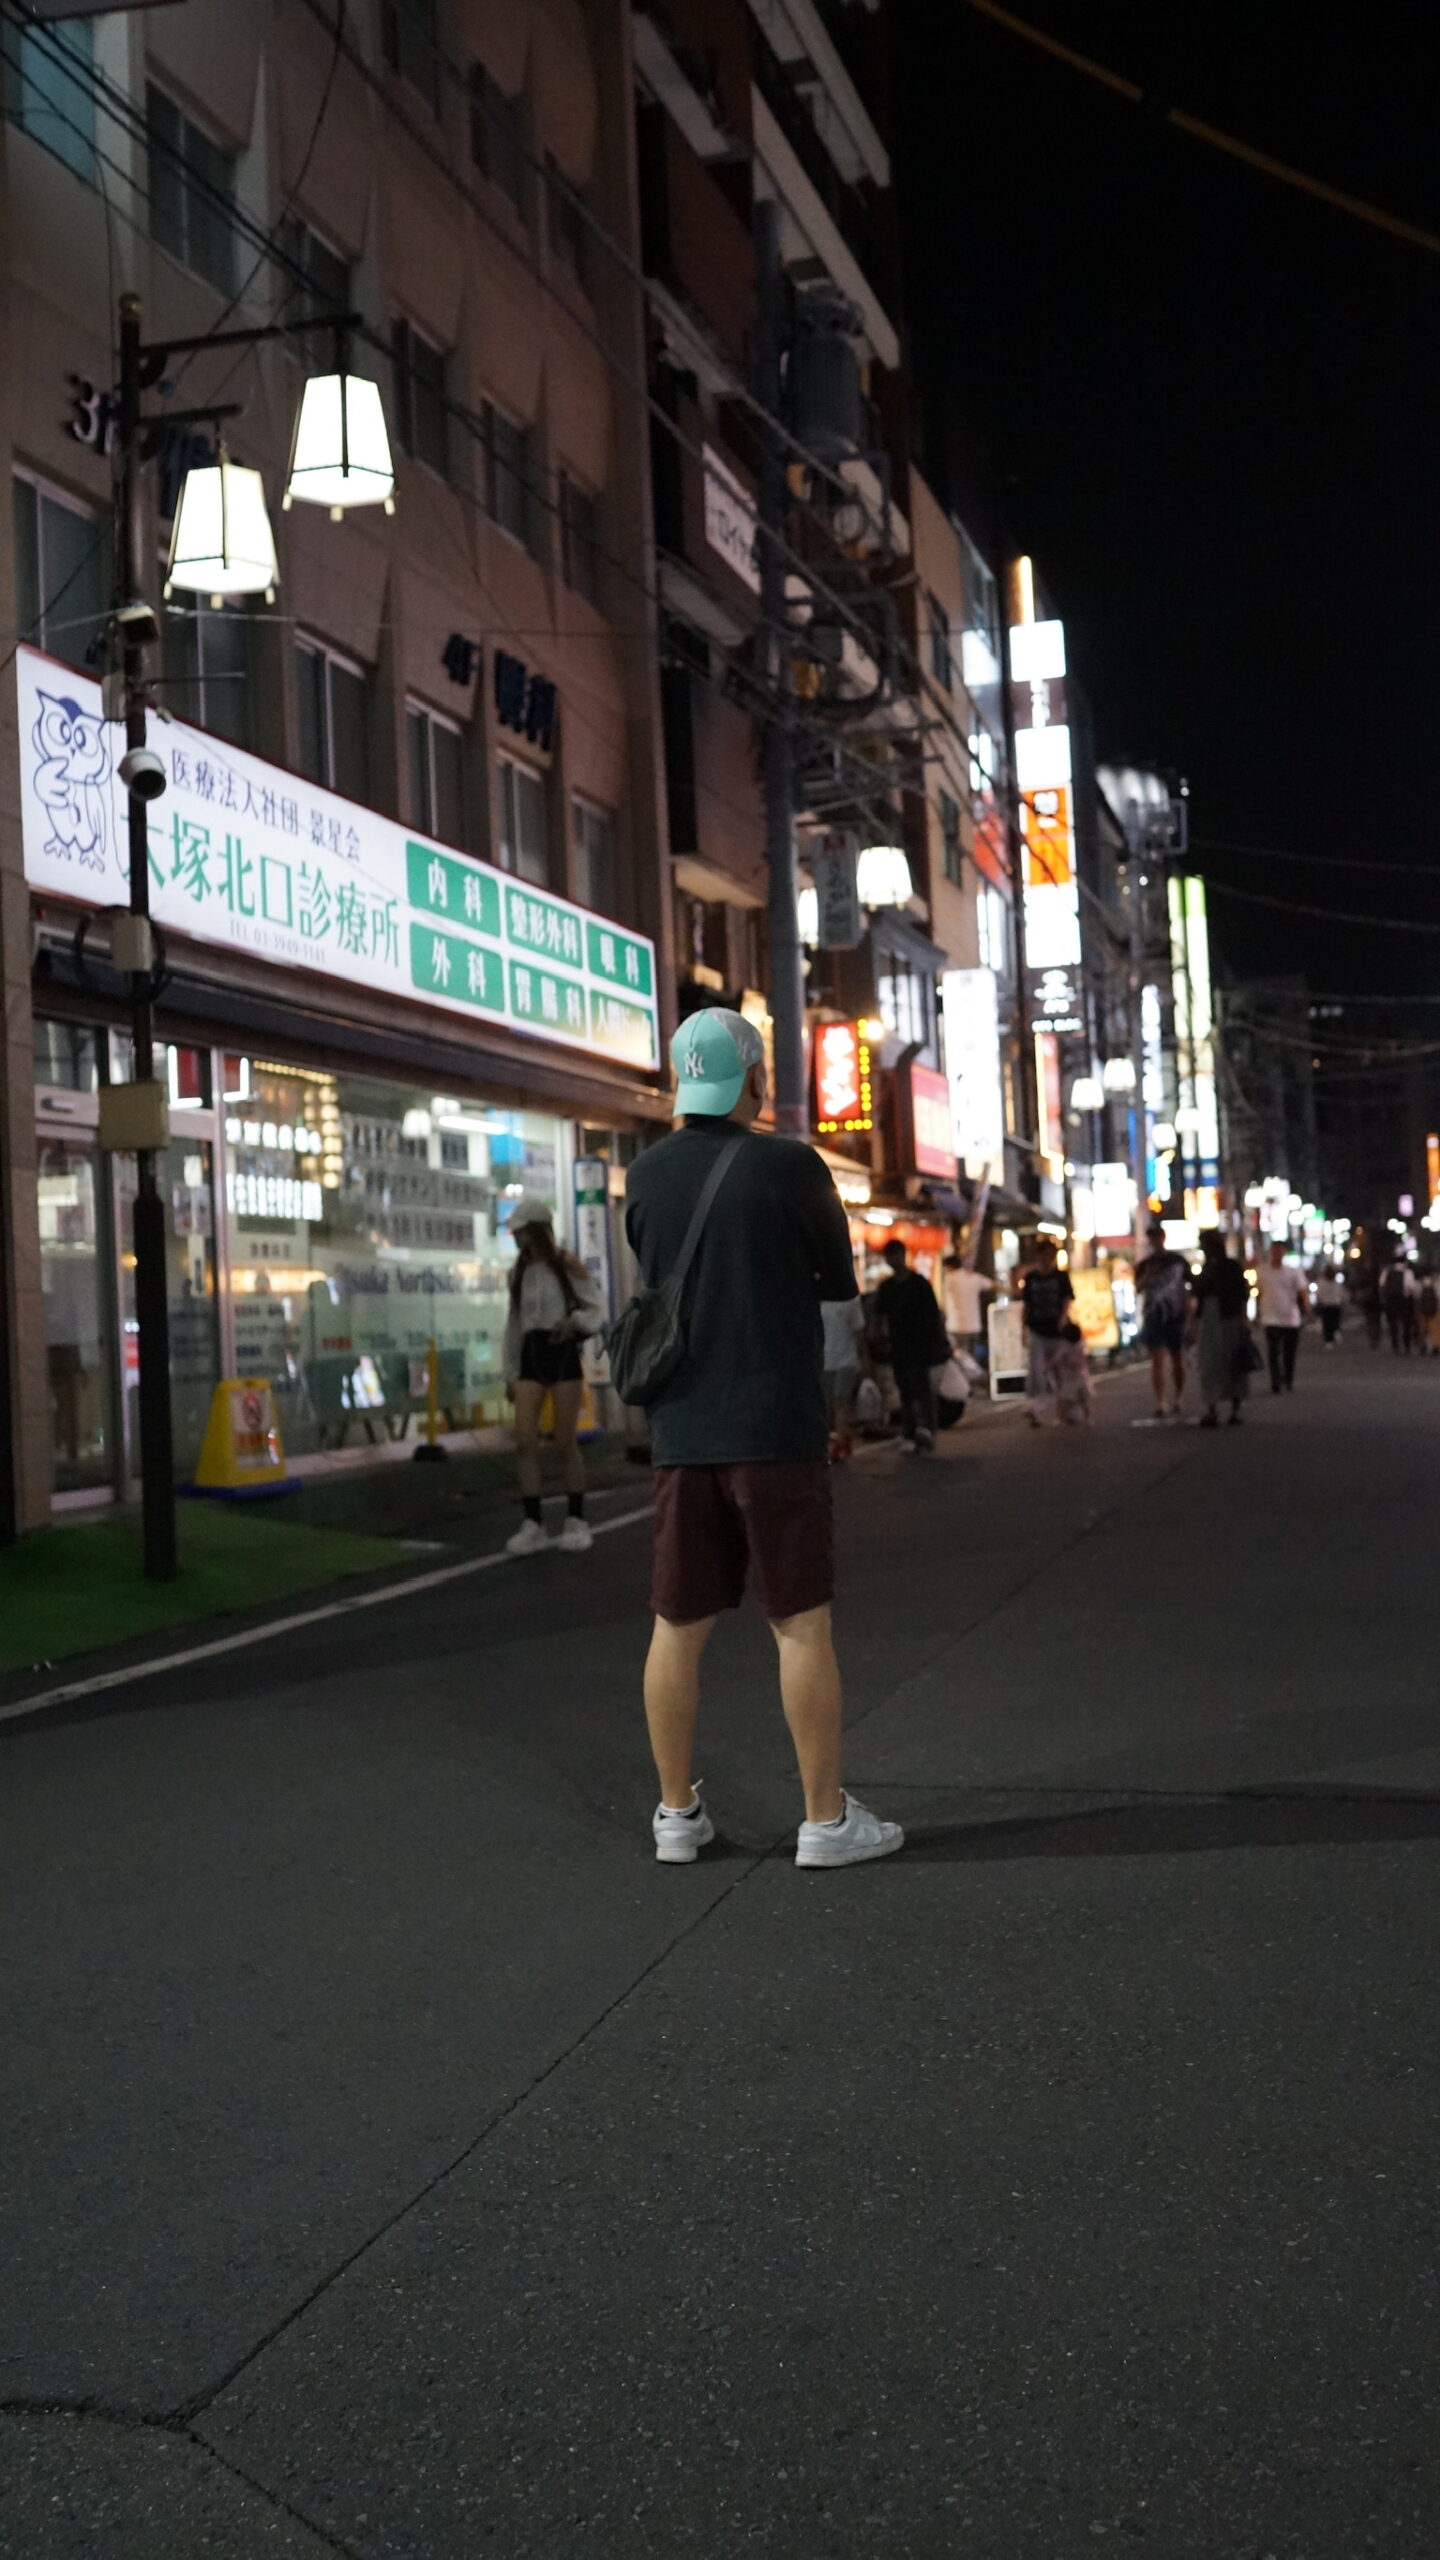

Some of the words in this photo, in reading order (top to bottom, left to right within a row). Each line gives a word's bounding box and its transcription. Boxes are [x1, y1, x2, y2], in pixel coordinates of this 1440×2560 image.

[171, 749, 299, 837] 医療法人社団
[120, 811, 400, 968] 大塚北口診療所
[427, 856, 483, 923] 内科
[509, 892, 578, 962] 整形外科
[599, 932, 640, 986] 眼科
[431, 935, 487, 999] 外科
[514, 966, 582, 1029] 胃腸科
[683, 1051, 705, 1078] NY
